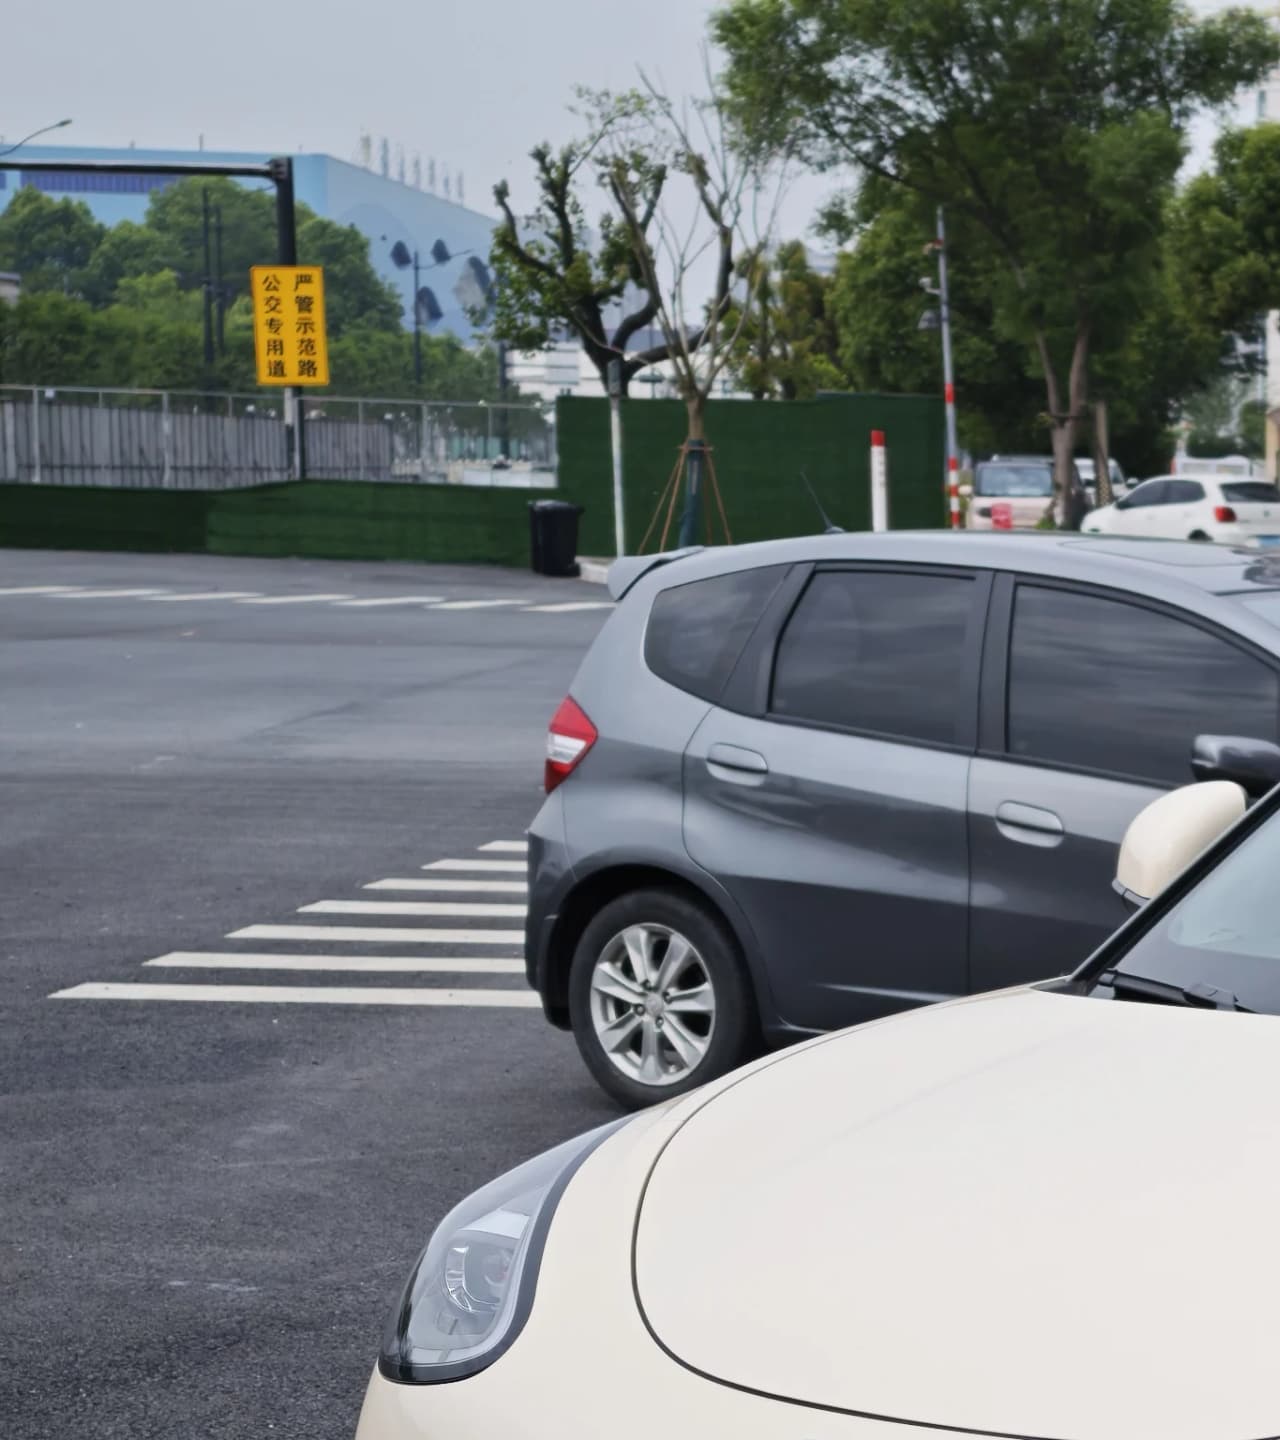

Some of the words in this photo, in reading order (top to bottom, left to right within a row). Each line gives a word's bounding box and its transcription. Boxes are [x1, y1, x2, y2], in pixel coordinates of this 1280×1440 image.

[262, 274, 287, 378] 公交专用道
[294, 274, 318, 378] 严管示范路
